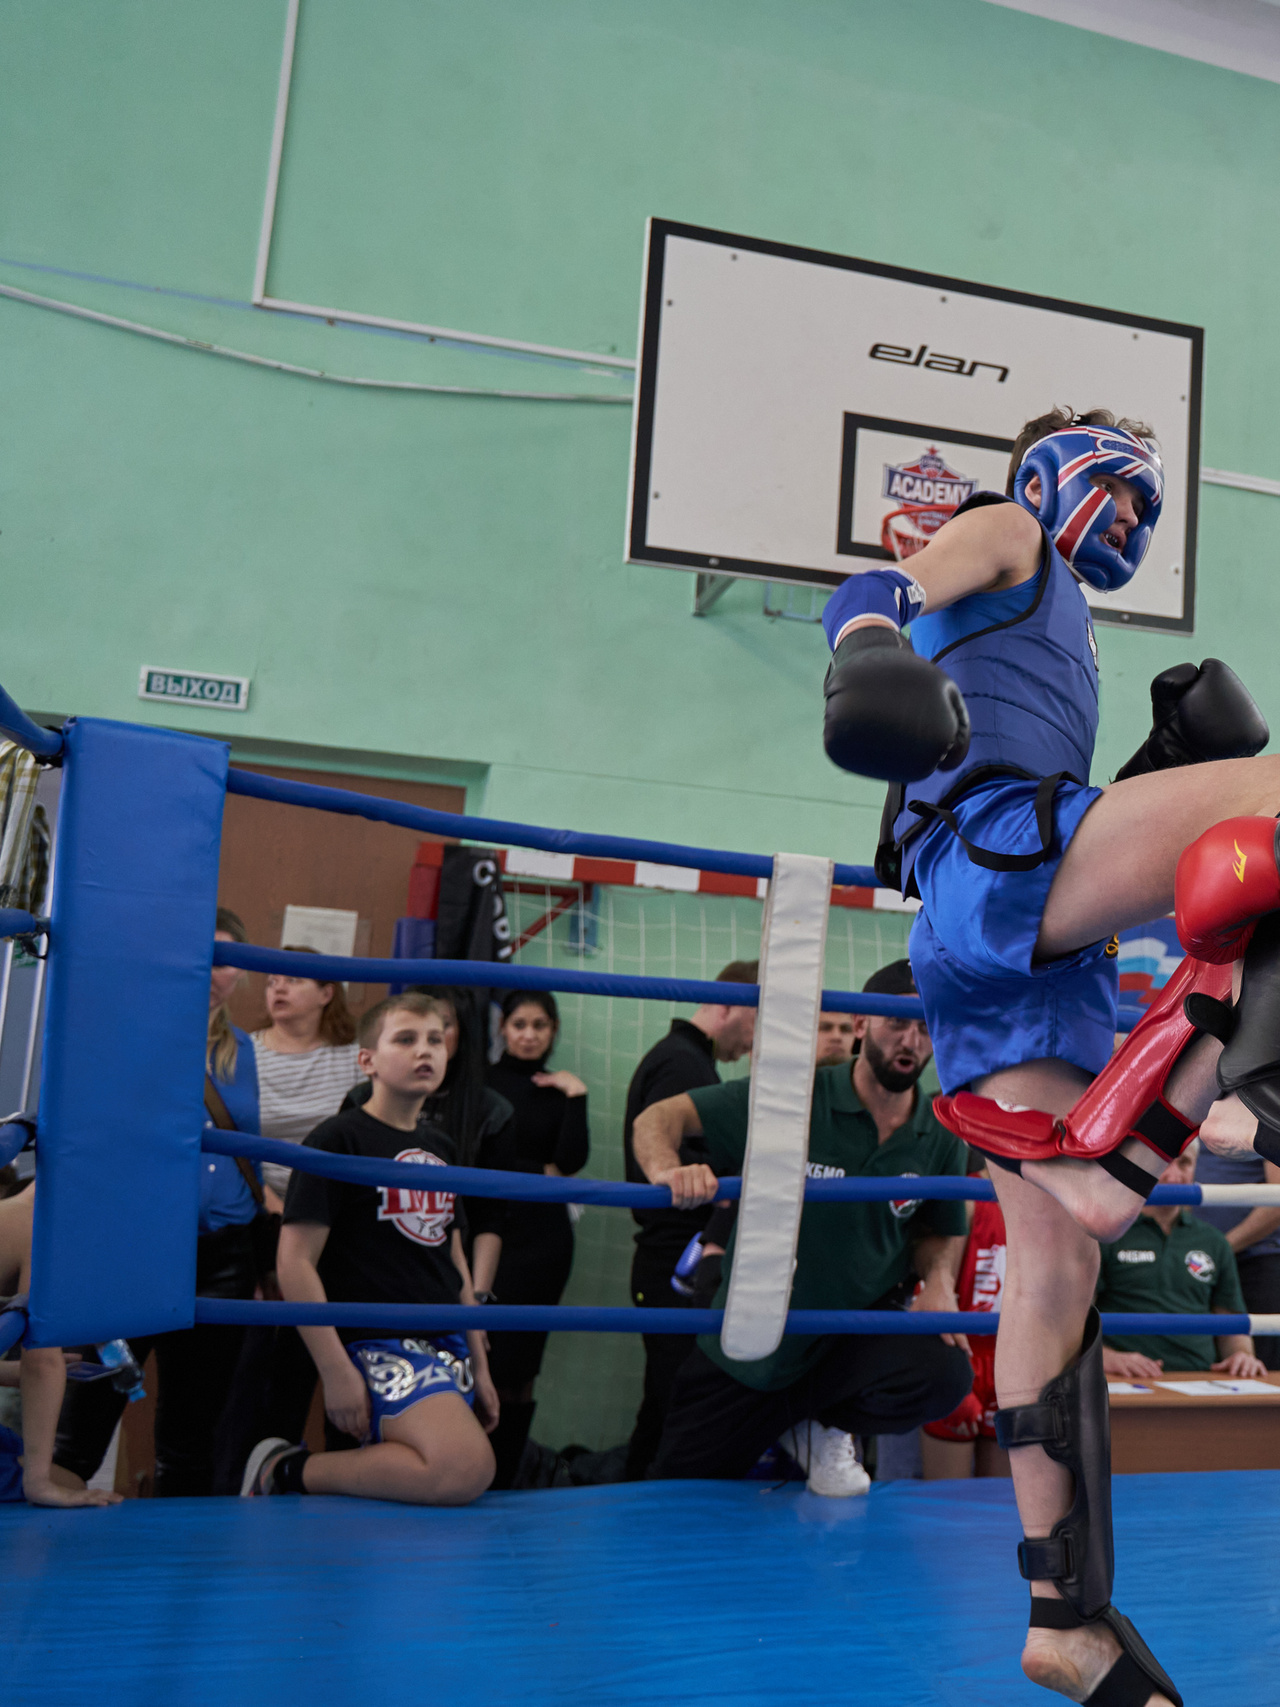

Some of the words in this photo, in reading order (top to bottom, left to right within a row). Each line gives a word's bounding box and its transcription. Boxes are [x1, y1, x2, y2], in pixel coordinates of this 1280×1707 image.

[868, 343, 1010, 383] elan
[890, 473, 971, 506] ACADEMY
[150, 673, 238, 703] ВЫХОД
[805, 1162, 846, 1179] КБМО
